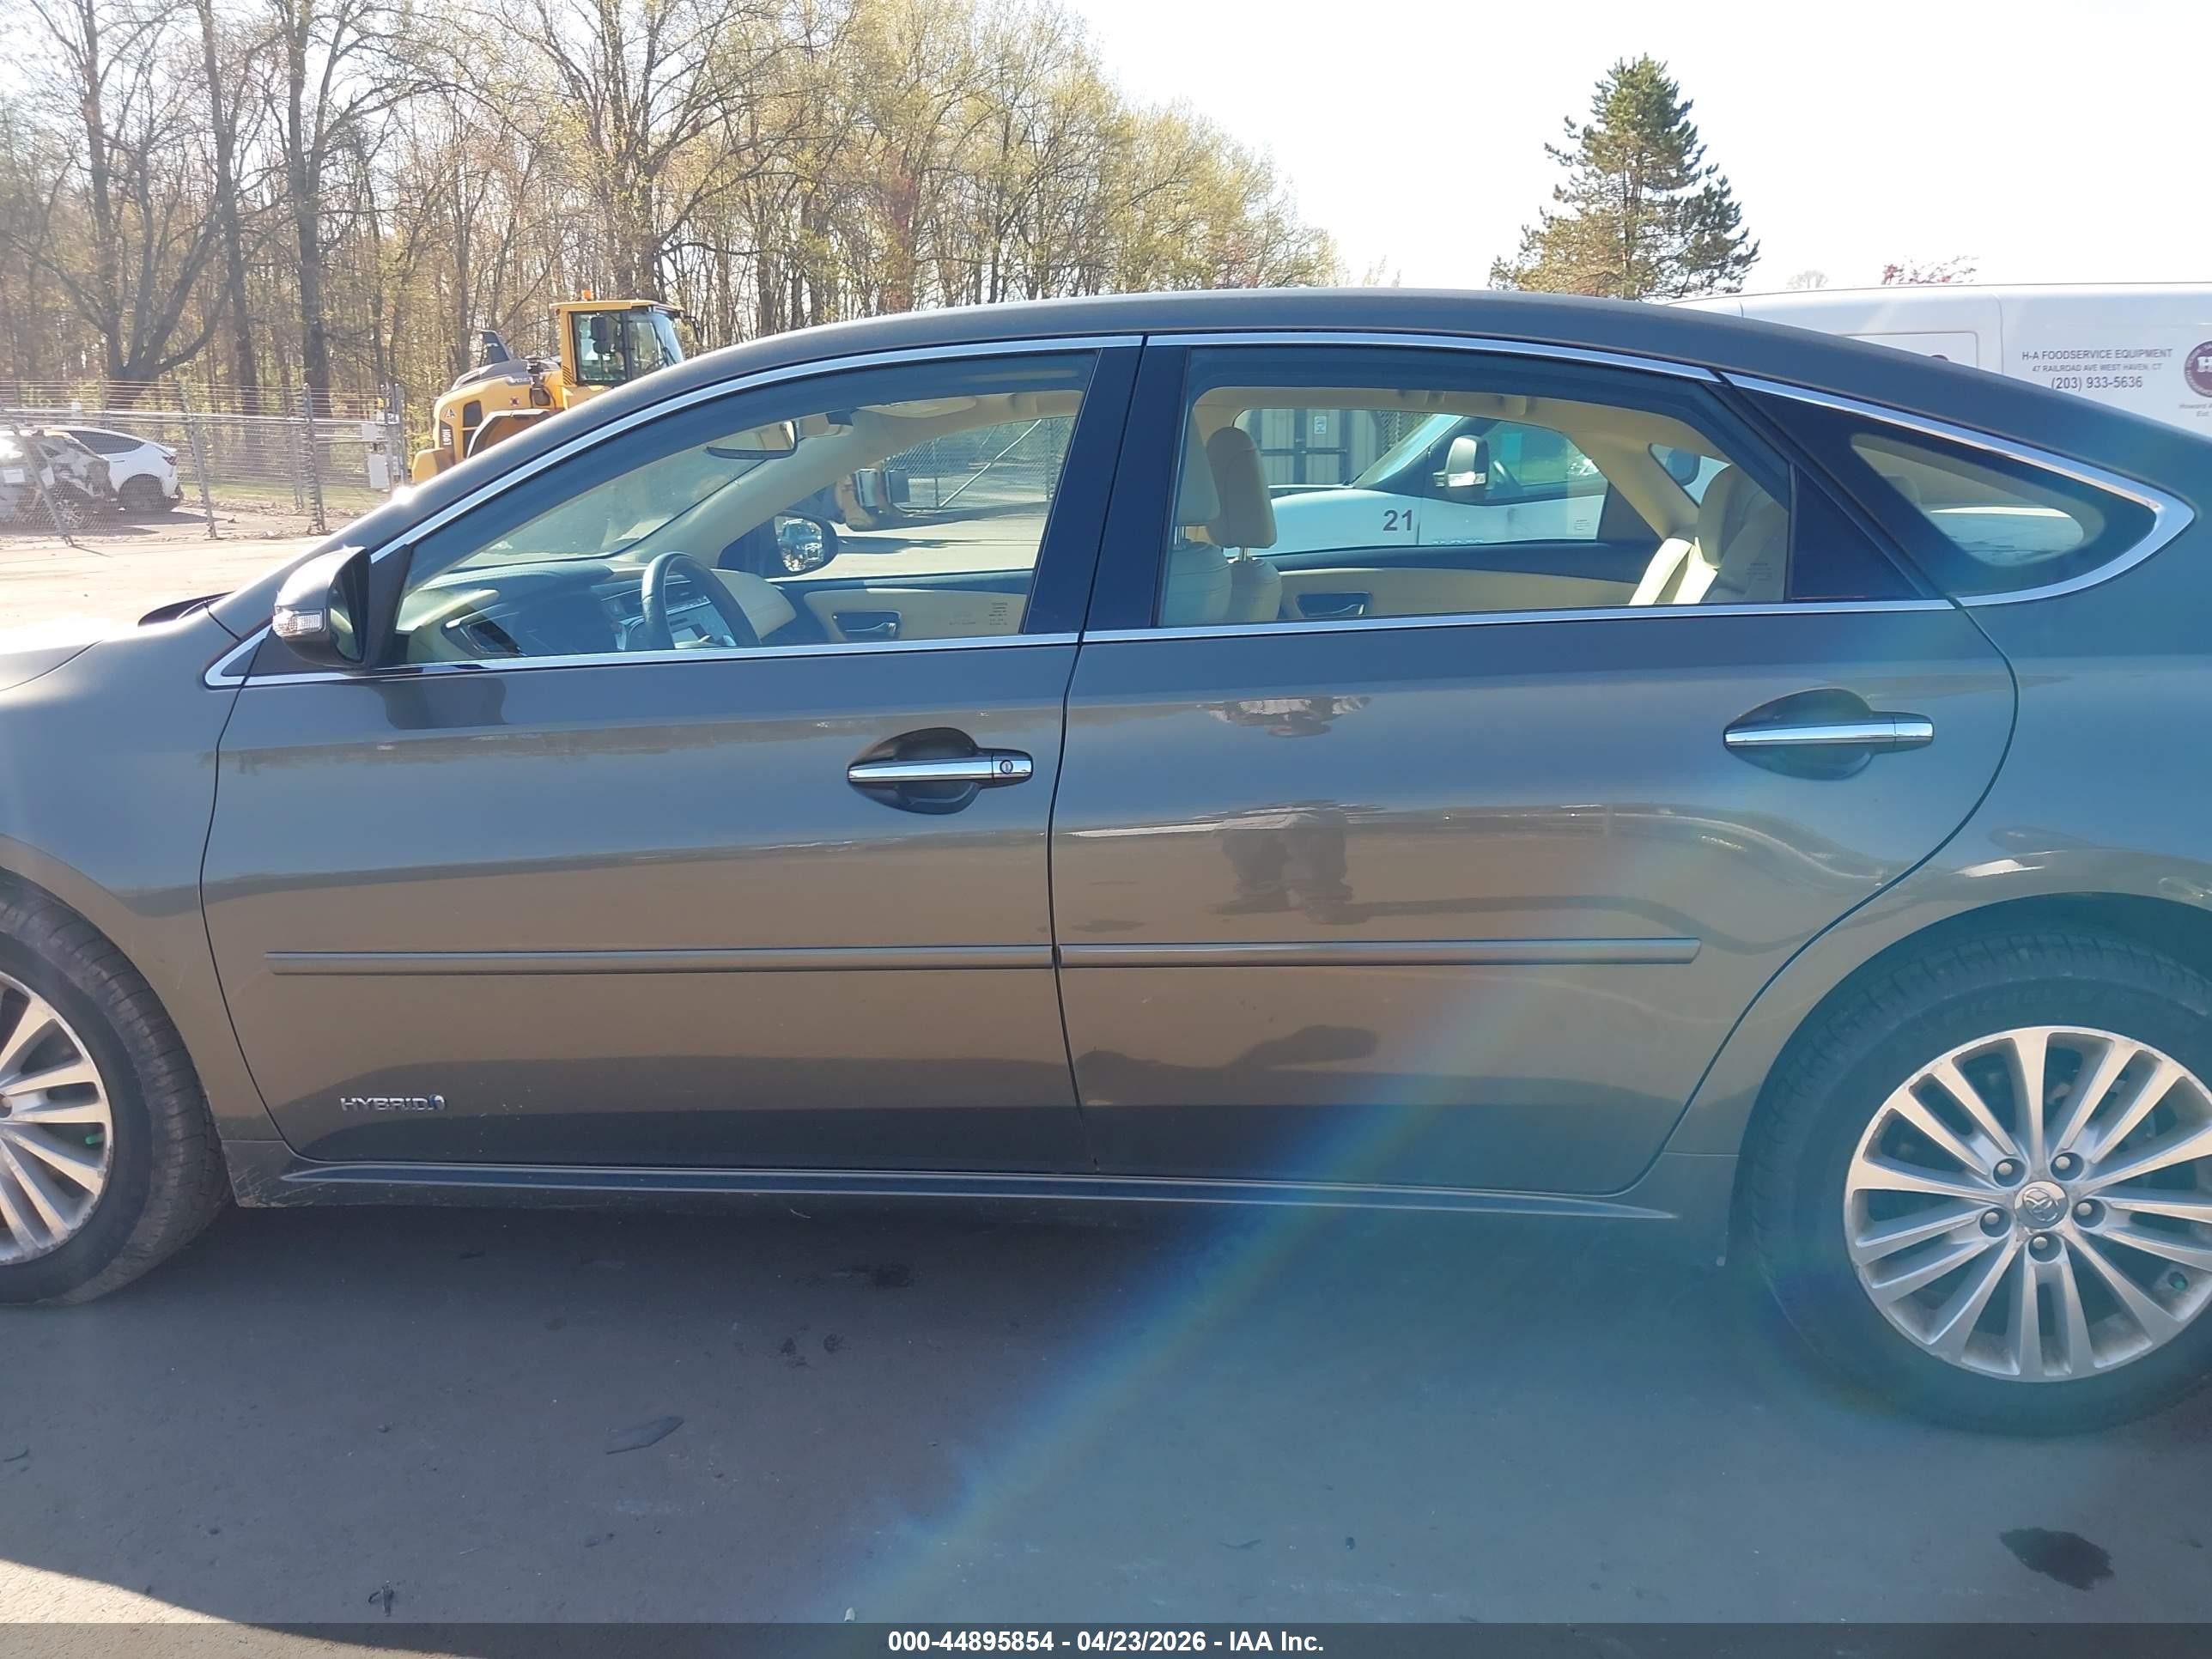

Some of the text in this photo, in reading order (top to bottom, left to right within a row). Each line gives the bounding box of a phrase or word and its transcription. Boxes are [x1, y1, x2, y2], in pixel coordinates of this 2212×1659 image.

[2021, 348, 2173, 360] H-A FOODSERVICE EQUIPMENT
[2083, 363, 2099, 372] AVE
[2051, 375, 2143, 392] (203) 933-5636
[1382, 509, 1413, 532] 21
[340, 1097, 428, 1111] HYBRID
